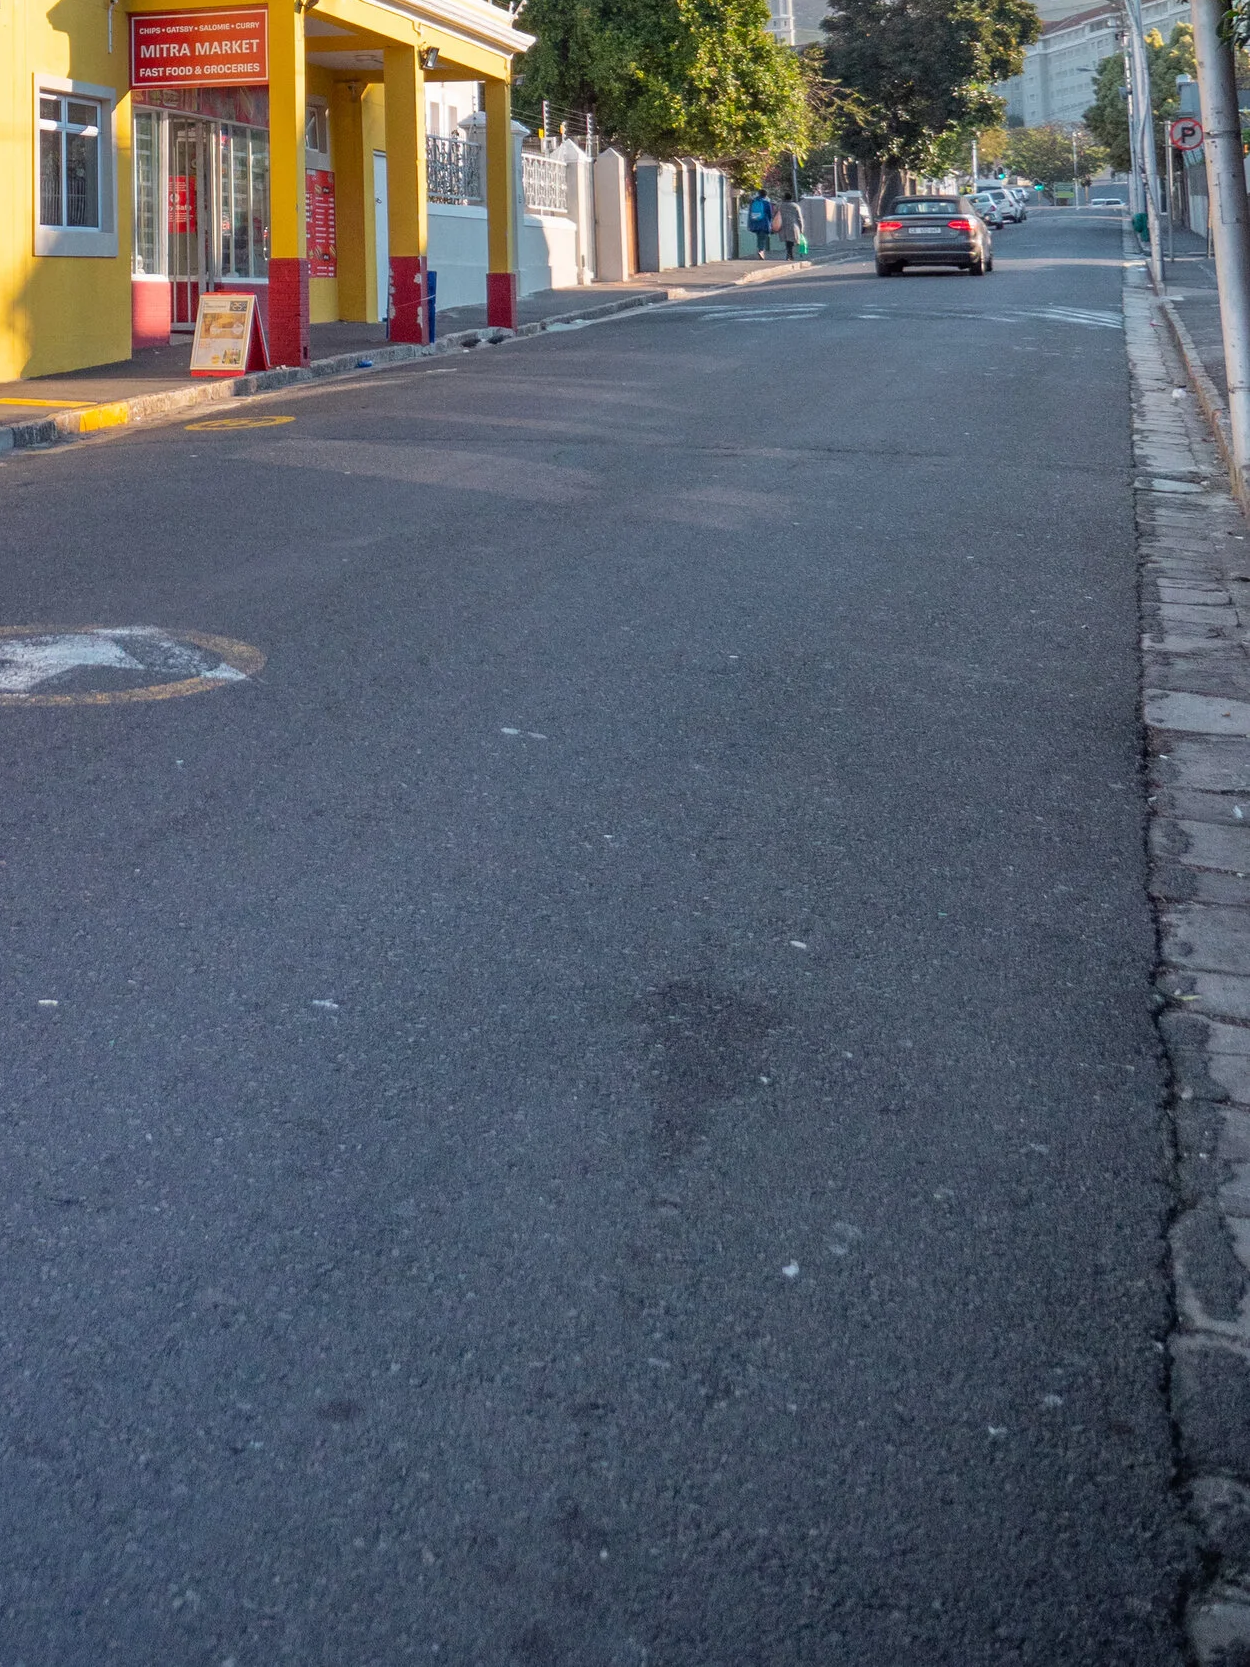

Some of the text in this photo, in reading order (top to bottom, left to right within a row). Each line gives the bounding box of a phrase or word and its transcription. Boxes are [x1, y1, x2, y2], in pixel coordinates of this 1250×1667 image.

[166, 25, 194, 33] GATSBY
[199, 23, 230, 32] SALOMIE
[235, 21, 260, 29] CURRY
[140, 39, 260, 58] MITRA MARKET
[139, 63, 260, 77] FAST FOOD & GROCERIES
[1181, 126, 1196, 143] P
